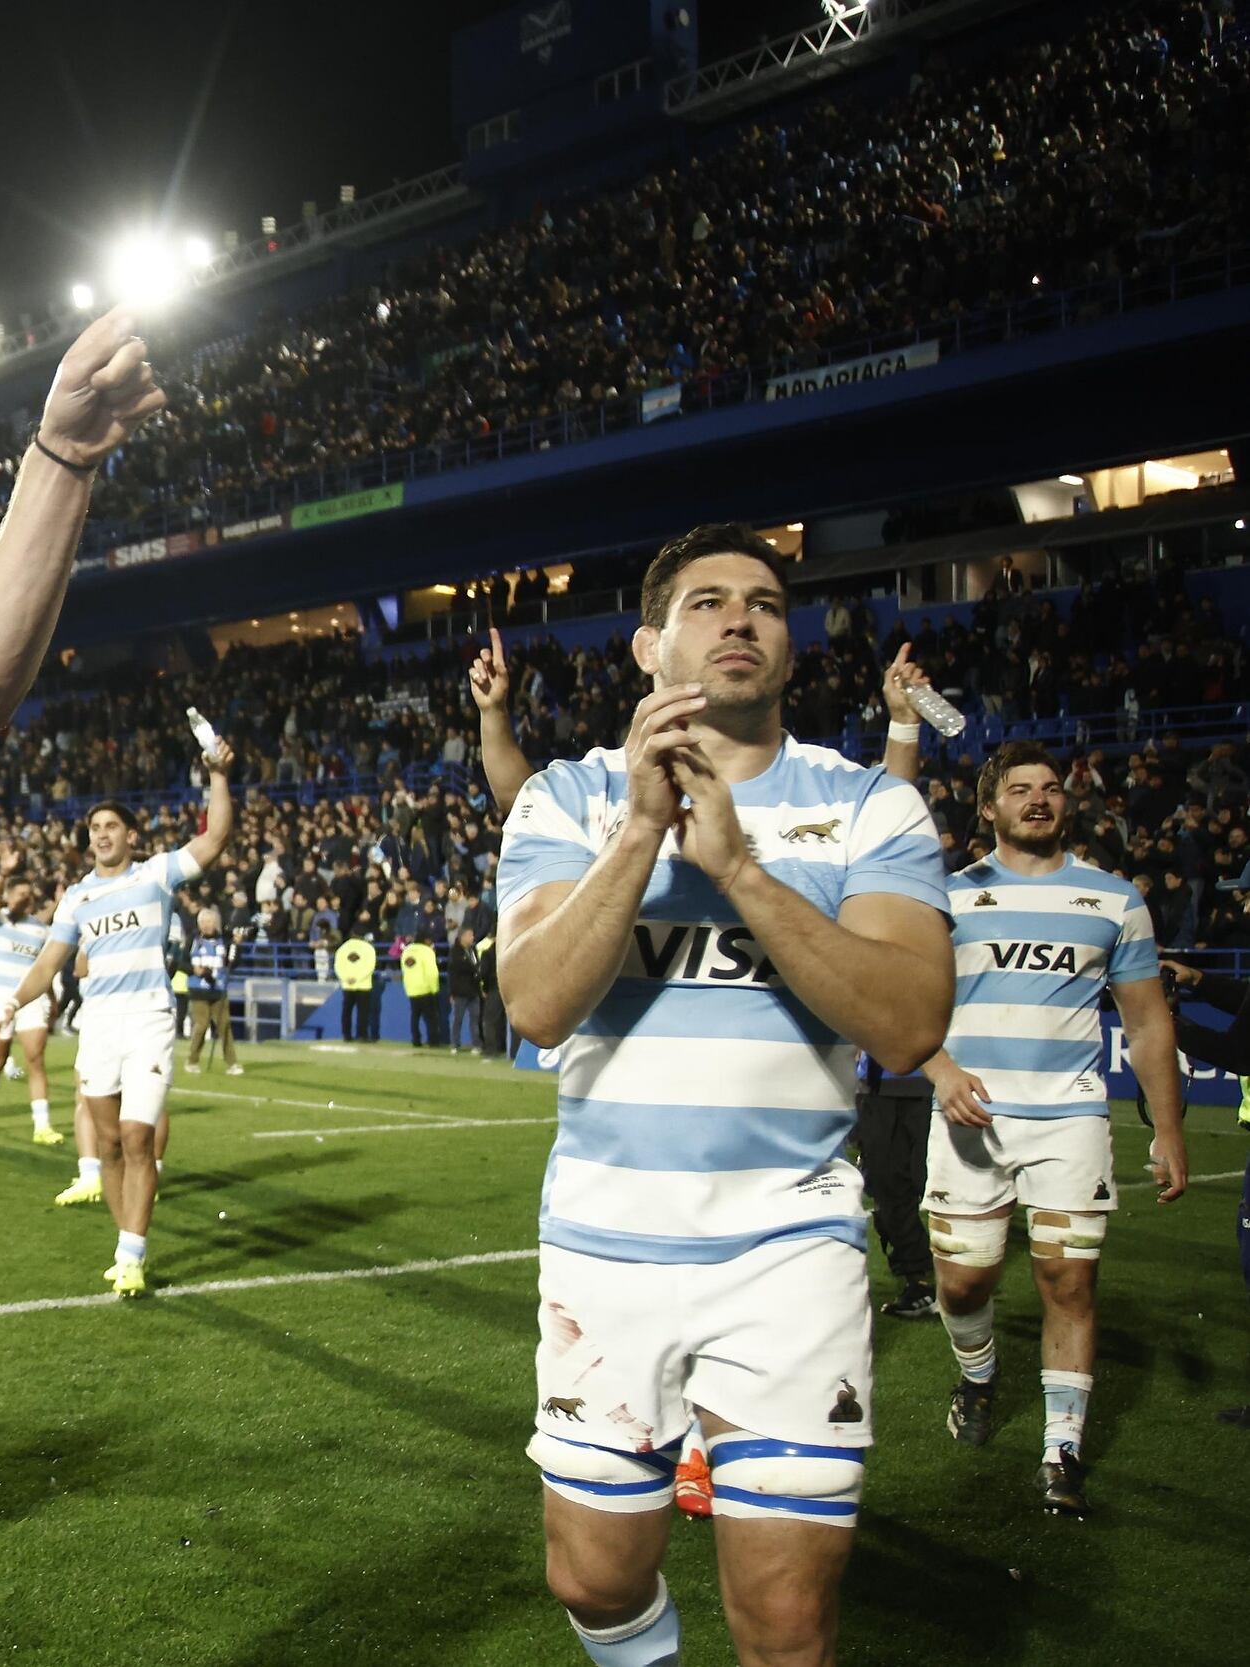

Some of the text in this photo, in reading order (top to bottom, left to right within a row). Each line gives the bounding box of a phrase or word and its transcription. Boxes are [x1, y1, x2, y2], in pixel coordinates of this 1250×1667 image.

[115, 538, 167, 568] SMS
[88, 910, 139, 936] VISA
[982, 943, 1076, 974] VISA
